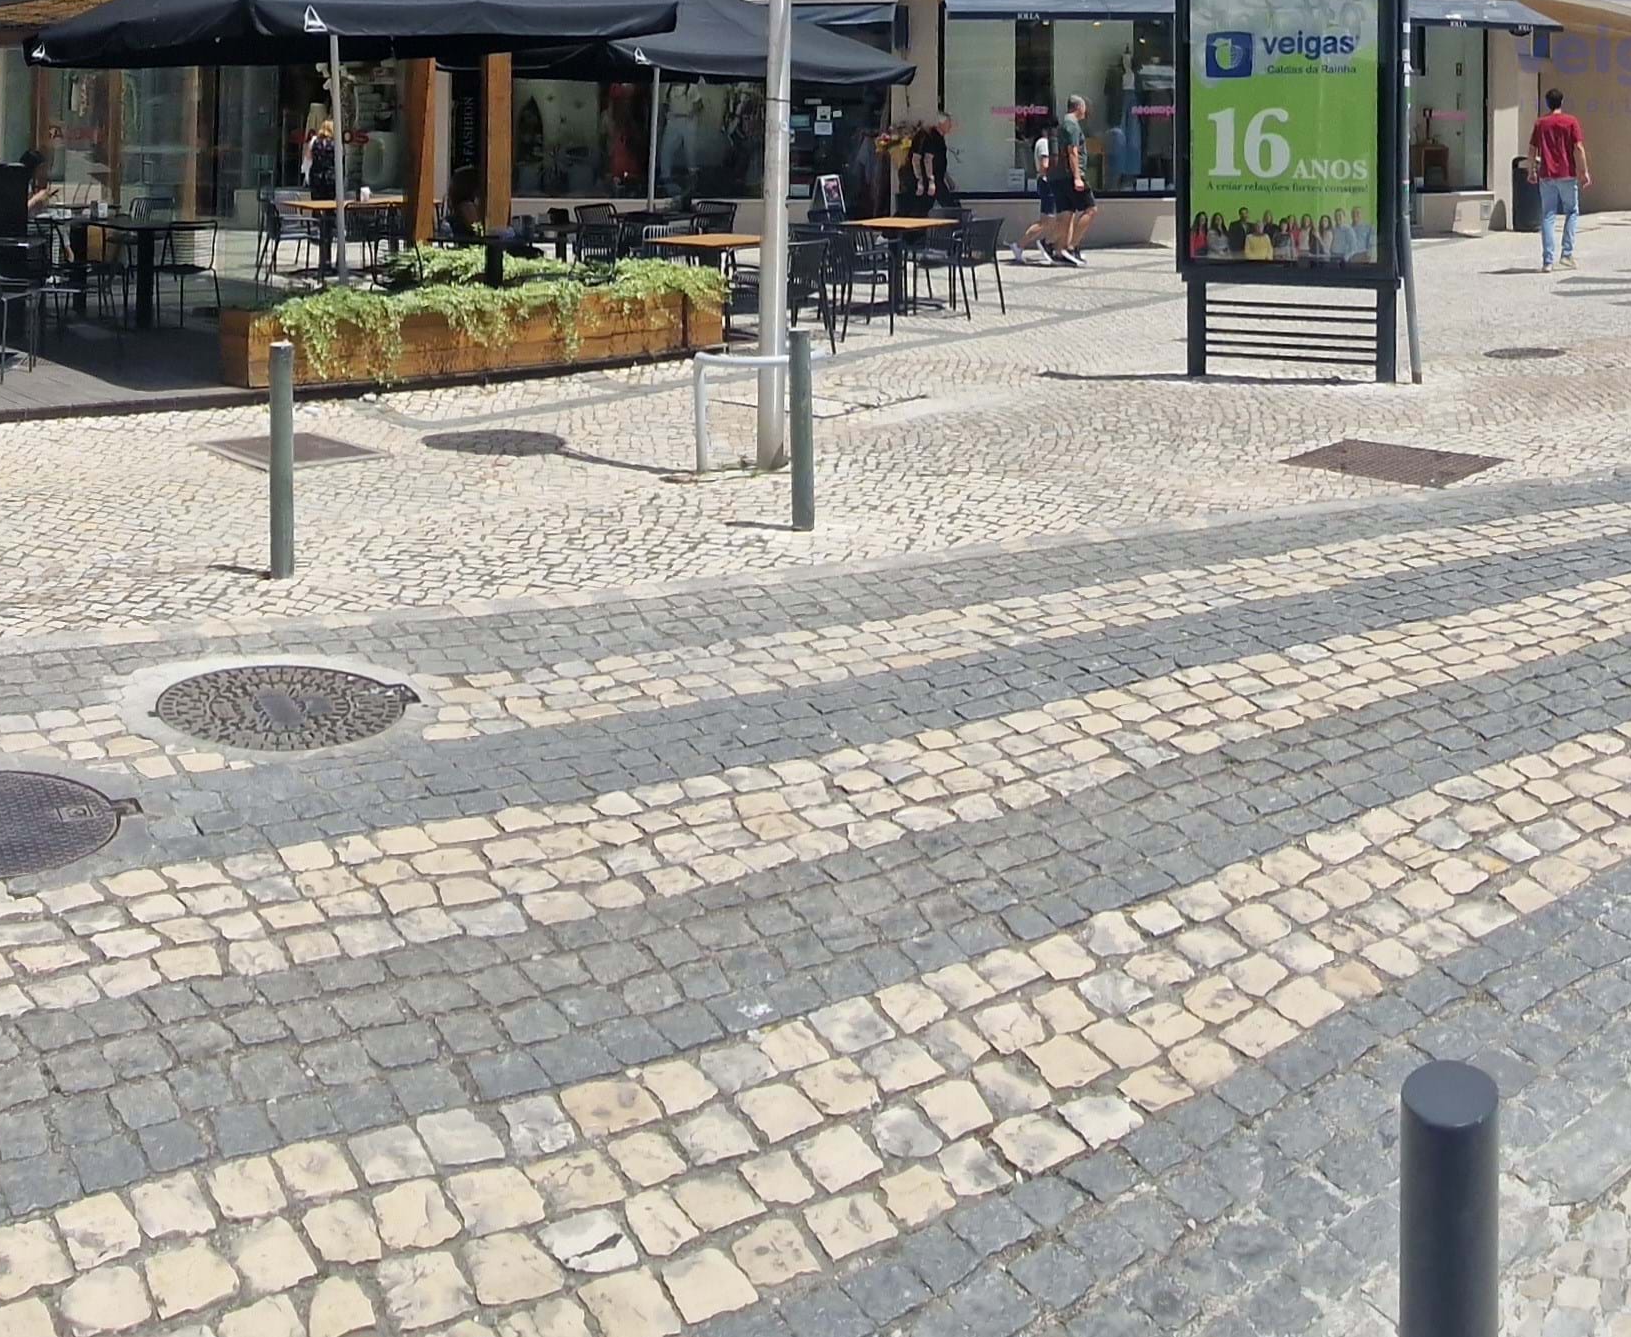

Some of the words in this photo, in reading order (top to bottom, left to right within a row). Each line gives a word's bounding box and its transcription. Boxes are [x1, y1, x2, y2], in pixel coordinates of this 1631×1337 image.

[1261, 30, 1355, 60] veigas
[1267, 65, 1303, 74] Caldas
[1305, 65, 1318, 74] da
[1321, 65, 1357, 74] Rainha
[1207, 108, 1291, 178] 16
[1292, 159, 1368, 180] ANOS
[1215, 181, 1242, 191] criar
